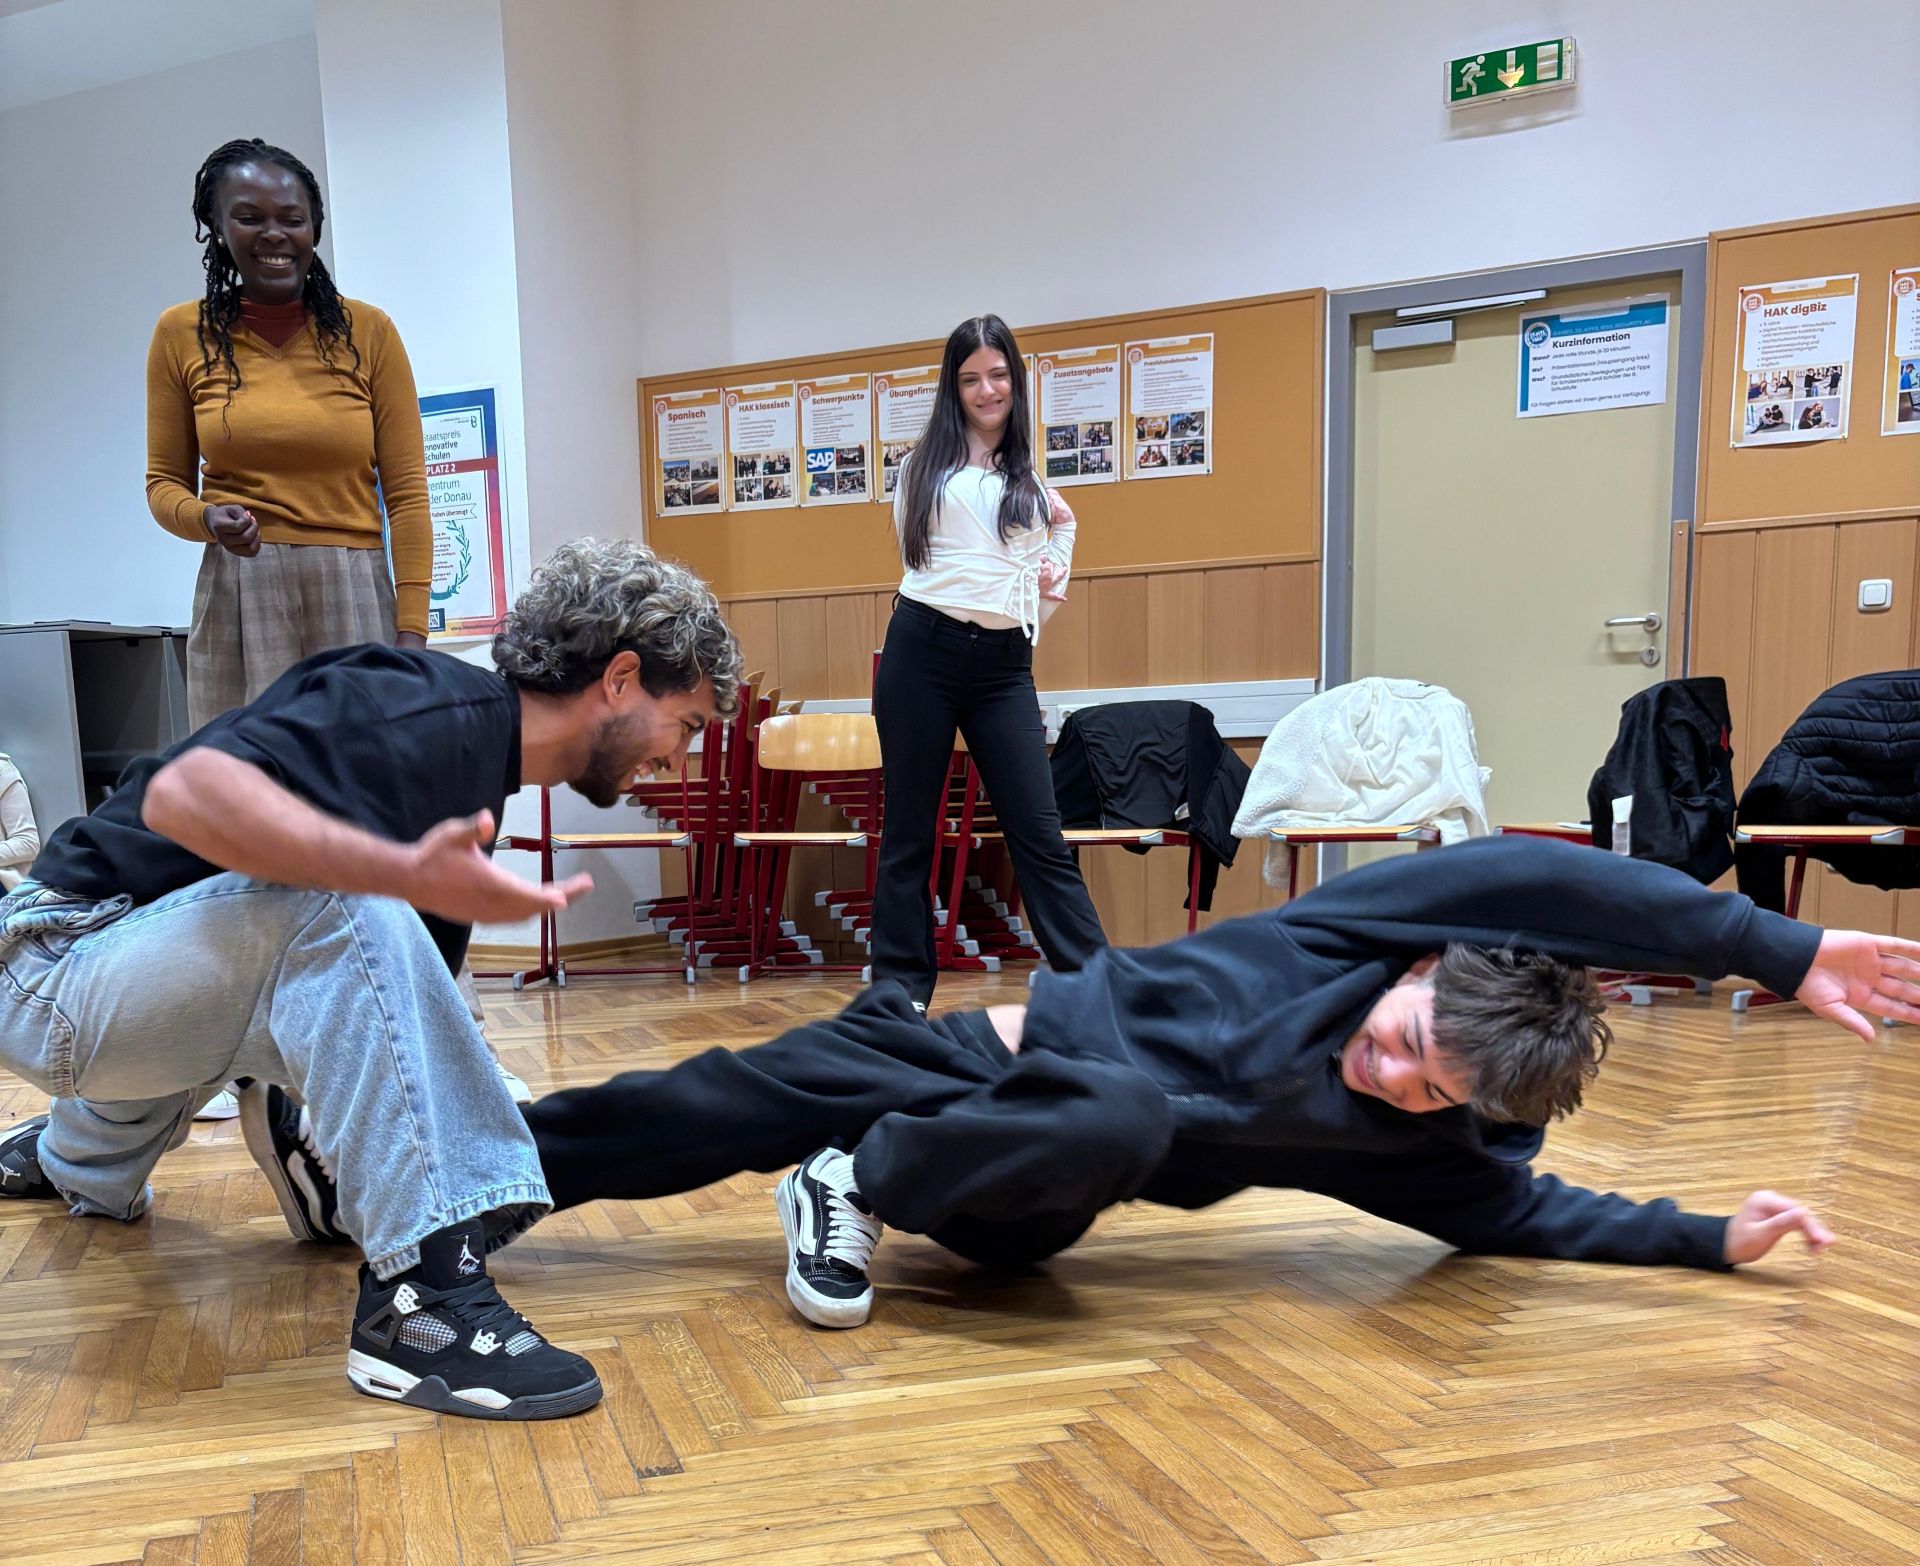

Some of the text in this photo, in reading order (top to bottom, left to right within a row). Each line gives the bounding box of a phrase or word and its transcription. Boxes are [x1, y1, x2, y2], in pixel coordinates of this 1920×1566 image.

[1764, 302, 1827, 318] HAK digBiz
[1552, 333, 1630, 349] Kurzinformation
[1054, 366, 1114, 379] Zusatzangebote
[812, 392, 865, 406] Schwerpunkte
[739, 400, 790, 412] HAK klassisch
[668, 410, 706, 422] Spanisch
[807, 452, 834, 468] SAP
[426, 464, 456, 476] PLATZ 2
[444, 492, 472, 503] Donau
